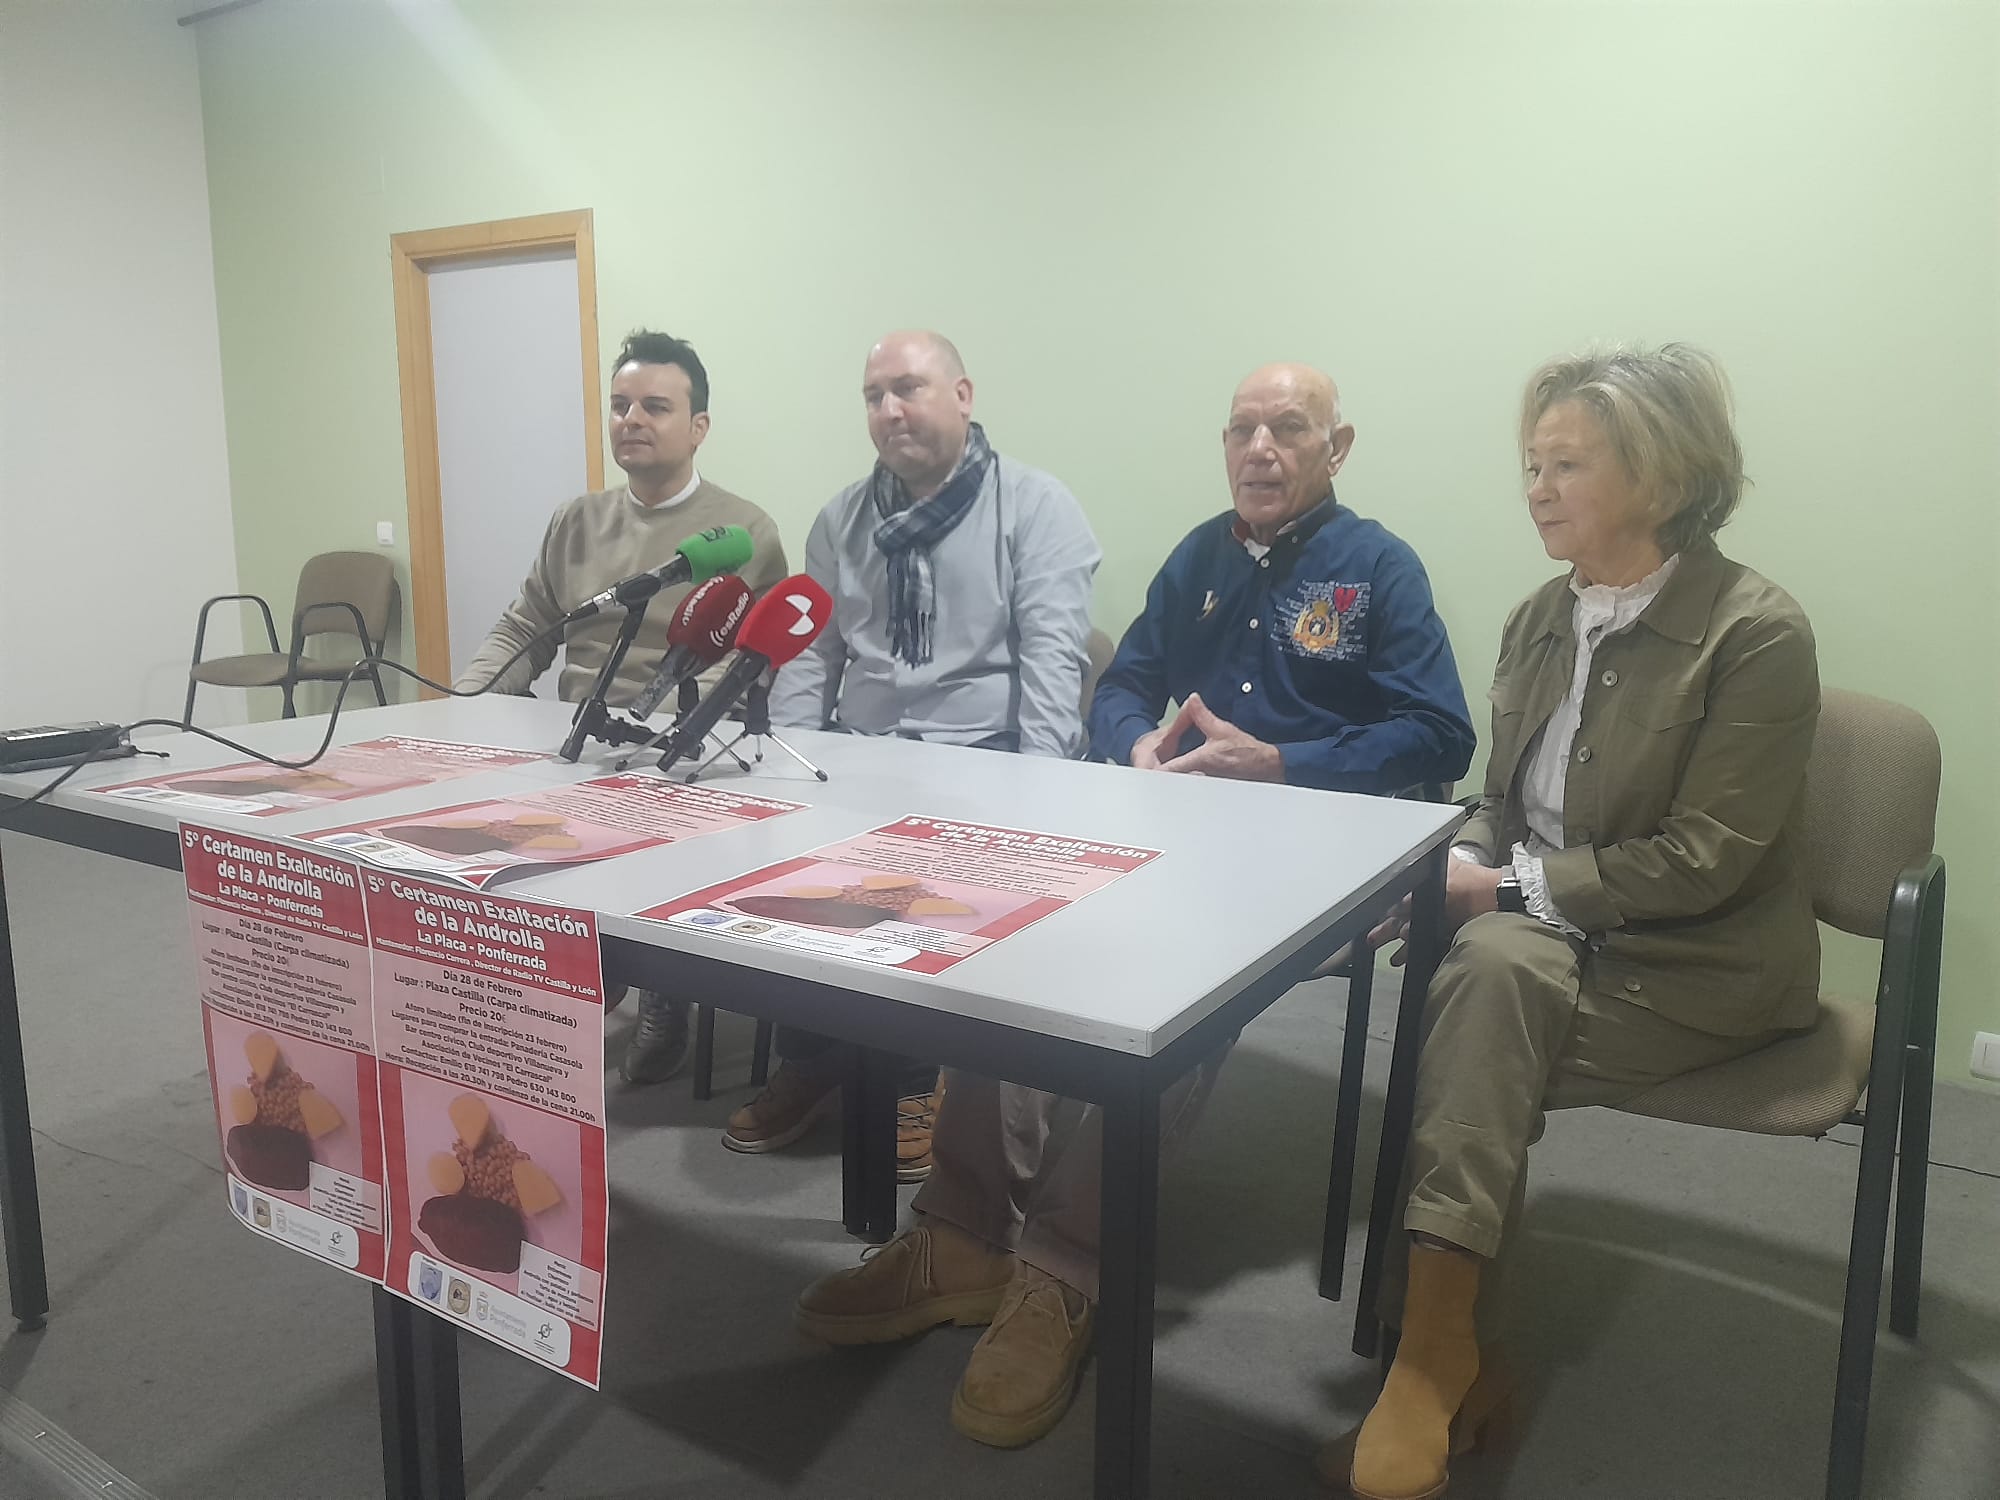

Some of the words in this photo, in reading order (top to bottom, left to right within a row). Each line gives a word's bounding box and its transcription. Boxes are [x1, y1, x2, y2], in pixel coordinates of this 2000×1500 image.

[932, 823, 1030, 841] Certamen
[1033, 837, 1148, 858] Exaltación
[992, 839, 1085, 856] Androlla
[203, 835, 273, 866] Certamen
[277, 851, 354, 888] Exaltación
[218, 860, 236, 879] de
[239, 864, 252, 883] la
[257, 869, 322, 900] Androlla
[219, 882, 230, 895] La
[232, 885, 258, 902] Placa
[267, 894, 323, 918] Ponferrada
[391, 881, 480, 915] Certamen
[482, 900, 589, 937] Exaltación
[264, 926, 272, 934] de
[275, 928, 303, 942] Febrero
[415, 906, 437, 926] de
[440, 911, 458, 931] la
[464, 917, 544, 951] Androlla
[226, 928, 244, 940] Plaza
[274, 942, 299, 955] (Carpa
[301, 949, 349, 969] climatizada)
[252, 948, 274, 961] Precio
[418, 929, 432, 943] La
[435, 933, 466, 951] Placa
[477, 943, 546, 970] Ponferrada
[395, 972, 418, 986] Lugar
[426, 980, 449, 993] Plaza
[452, 987, 484, 1002] Castilla
[487, 996, 517, 1011] (Carpa
[520, 1005, 577, 1028] climatizada)
[461, 974, 471, 984] 28
[474, 978, 484, 988] de
[488, 981, 522, 997] Febrero
[534, 974, 543, 983] TV
[545, 977, 571, 989] Castilla
[578, 985, 596, 996] León
[460, 1003, 487, 1017] Precio
[471, 1030, 477, 1038] la
[550, 1053, 582, 1069] Casasola
[473, 1020, 482, 1028] de
[526, 1034, 534, 1042] 23
[536, 1037, 567, 1053] febrero)
[469, 1041, 485, 1051] Club
[487, 1047, 522, 1062] deportivo
[524, 1057, 562, 1075] Villanueva
[507, 1075, 528, 1088] Pedro
[530, 1083, 544, 1093] 630
[546, 1088, 559, 1097] 143
[561, 1092, 576, 1103] 800
[531, 1095, 540, 1103] de
[542, 1098, 548, 1106] la
[551, 1103, 568, 1113] cena
[570, 1107, 595, 1121] 21.00h
